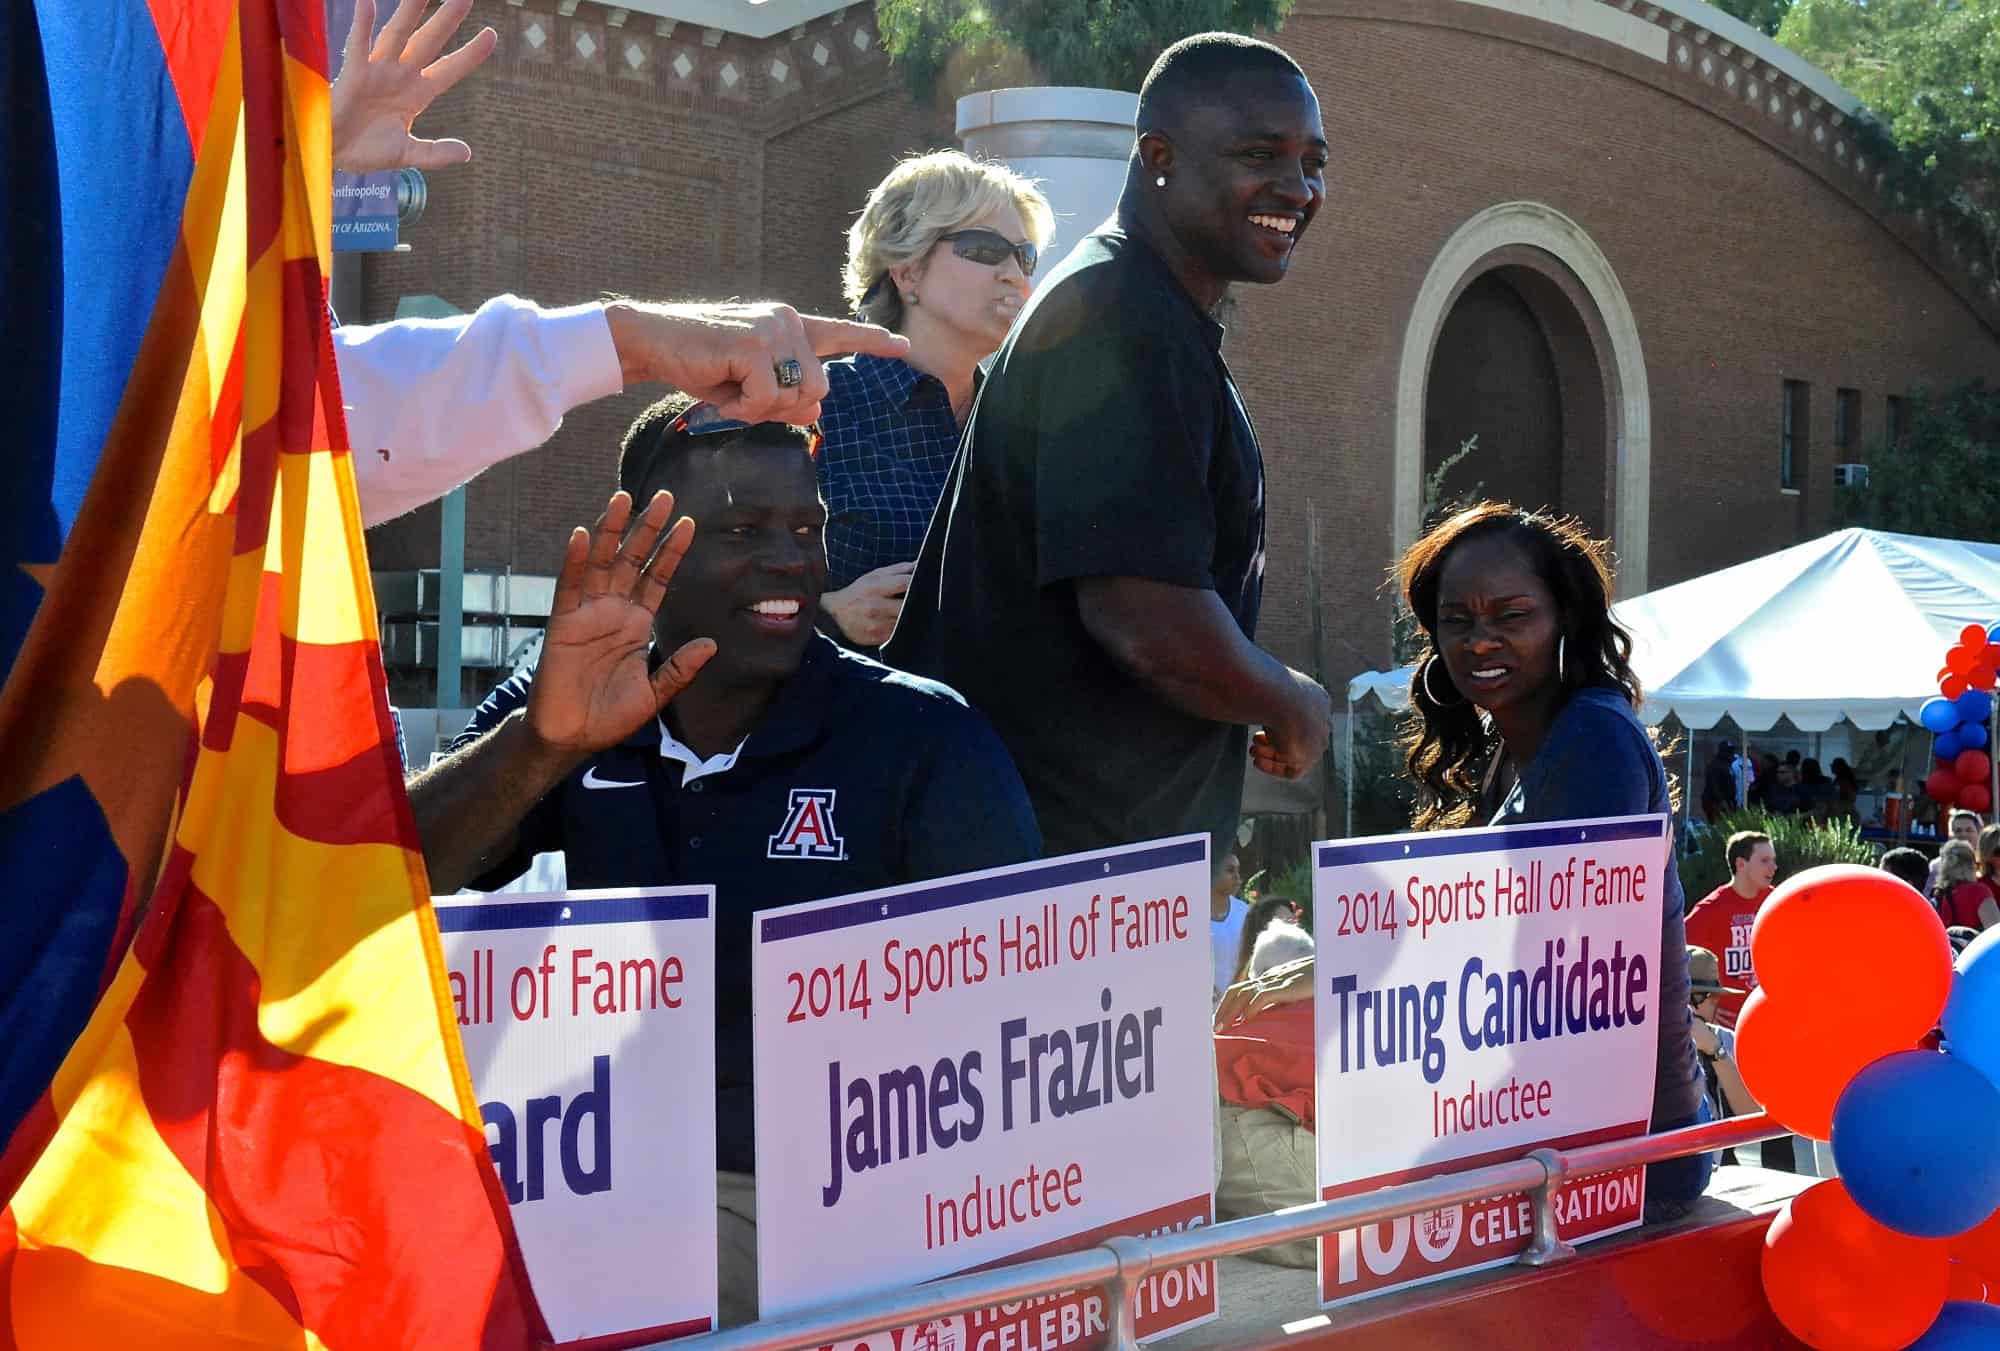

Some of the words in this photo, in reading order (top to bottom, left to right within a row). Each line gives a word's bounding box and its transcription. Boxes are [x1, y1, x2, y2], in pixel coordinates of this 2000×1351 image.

[1336, 888, 1398, 941] 2014
[1406, 871, 1486, 939] Sports
[1495, 860, 1541, 919] Hall
[1549, 857, 1577, 909] of
[1582, 859, 1647, 910] Fame
[448, 949, 494, 1026] all
[511, 944, 557, 1021] of
[572, 949, 684, 1017] Fame
[786, 959, 872, 1024] 2014
[883, 926, 988, 1014] Sports
[999, 903, 1059, 977] Hall
[1069, 894, 1100, 960] of
[1110, 893, 1190, 953] Fame
[1331, 974, 1447, 1085] Trung
[1458, 936, 1648, 1052] Candidate
[479, 1055, 612, 1205] ard
[822, 1050, 985, 1208] James
[1000, 987, 1163, 1132] Frazier
[1433, 1076, 1552, 1139] Inductee
[925, 1162, 1083, 1250] Inductee
[1469, 1174, 1639, 1247] CELERATION
[975, 1261, 1208, 1351] CELEBRTION
